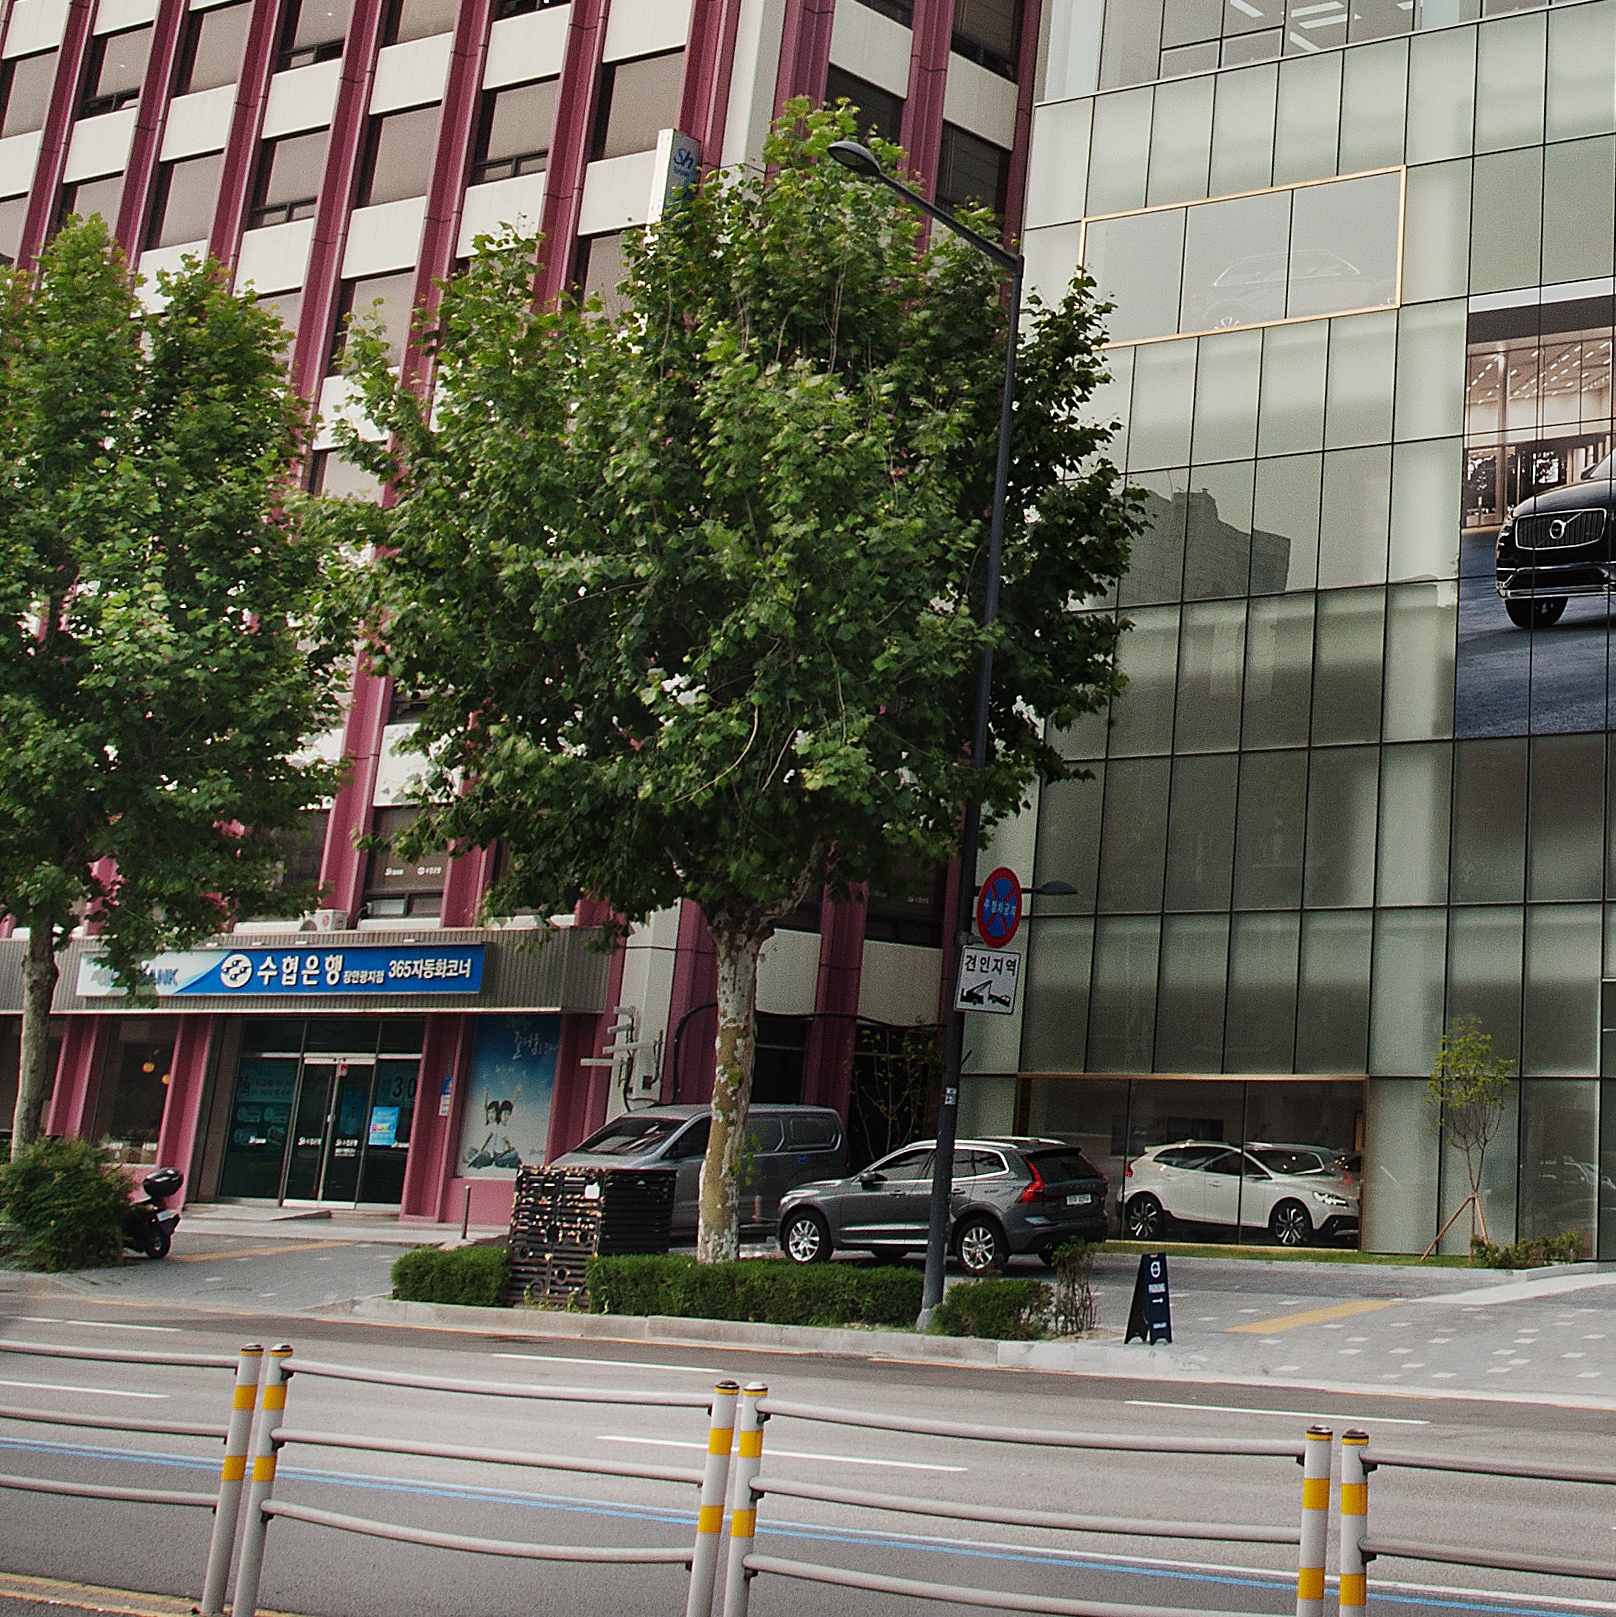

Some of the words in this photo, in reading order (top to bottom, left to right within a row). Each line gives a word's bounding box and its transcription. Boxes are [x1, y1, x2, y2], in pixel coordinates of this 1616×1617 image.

[257, 953, 344, 986] 수협은행
[388, 958, 472, 980] 365자동화코너
[964, 953, 1018, 977] 견인지역
